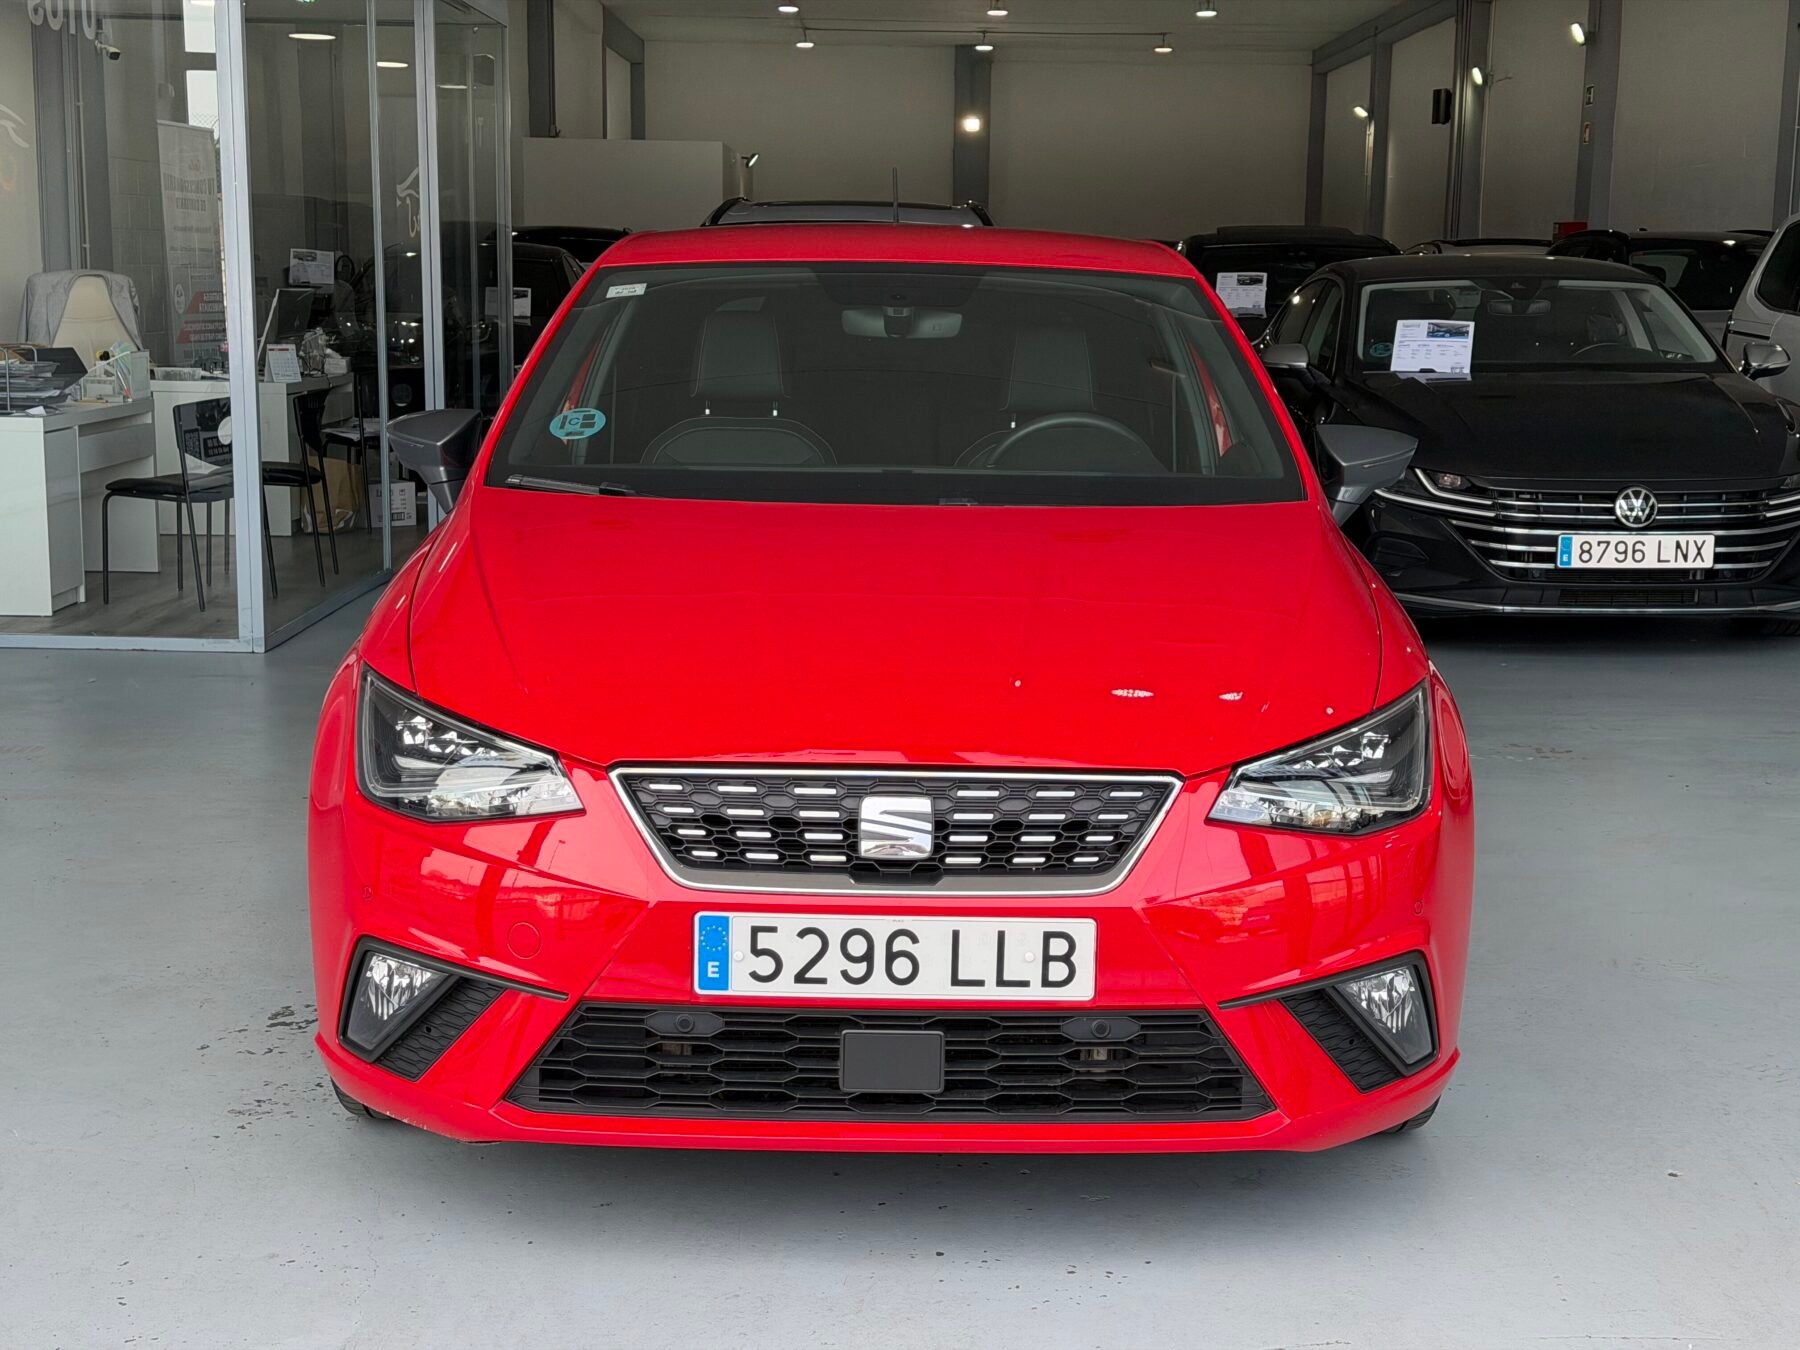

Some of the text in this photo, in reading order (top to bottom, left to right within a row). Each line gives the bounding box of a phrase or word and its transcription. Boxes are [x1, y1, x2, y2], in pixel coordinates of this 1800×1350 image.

[1579, 540, 1646, 564] 8796
[1657, 539, 1706, 563] LNX
[707, 925, 1077, 988] E 5296 LLB
